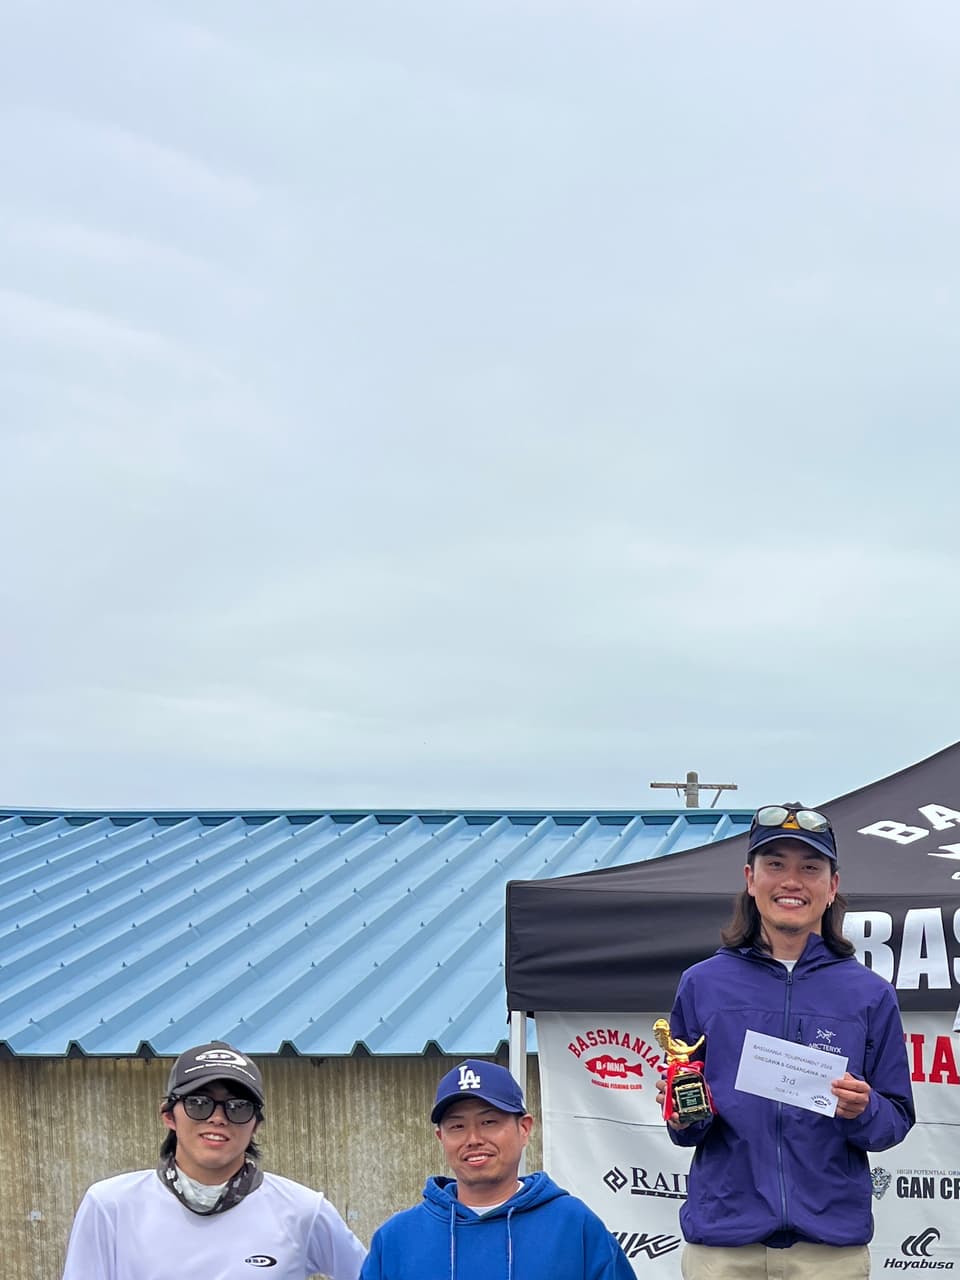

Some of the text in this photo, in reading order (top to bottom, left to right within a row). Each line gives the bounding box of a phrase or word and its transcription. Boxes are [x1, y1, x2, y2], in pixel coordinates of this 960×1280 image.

[568, 1029, 661, 1069] BASSMANIA
[457, 1065, 481, 1091] LA
[780, 1075, 796, 1086] 3rd
[896, 1176, 935, 1199] GAN
[883, 1258, 955, 1271] Hayabusa
